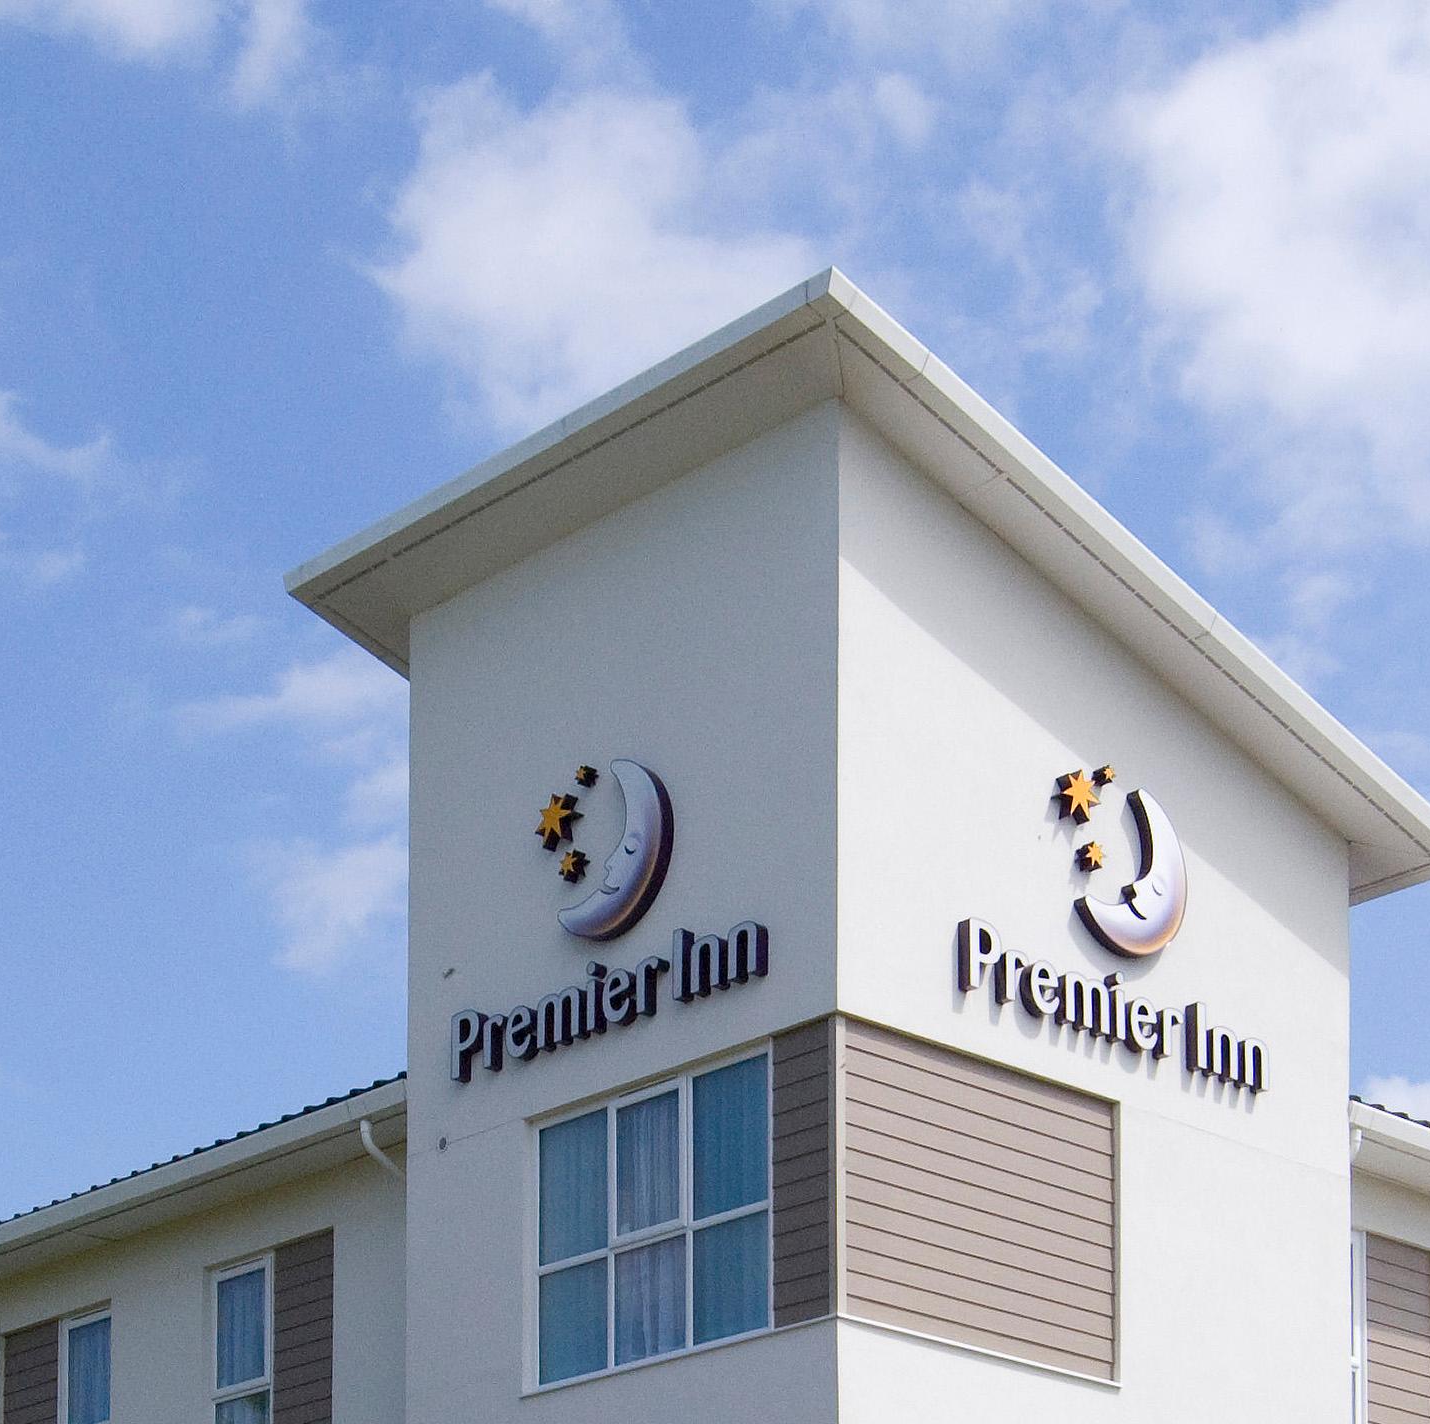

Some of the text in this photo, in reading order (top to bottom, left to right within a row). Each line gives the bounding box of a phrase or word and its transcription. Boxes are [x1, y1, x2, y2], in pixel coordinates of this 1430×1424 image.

[450, 920, 769, 1083] Premier Inn
[958, 917, 1270, 1094] Premier Inn
